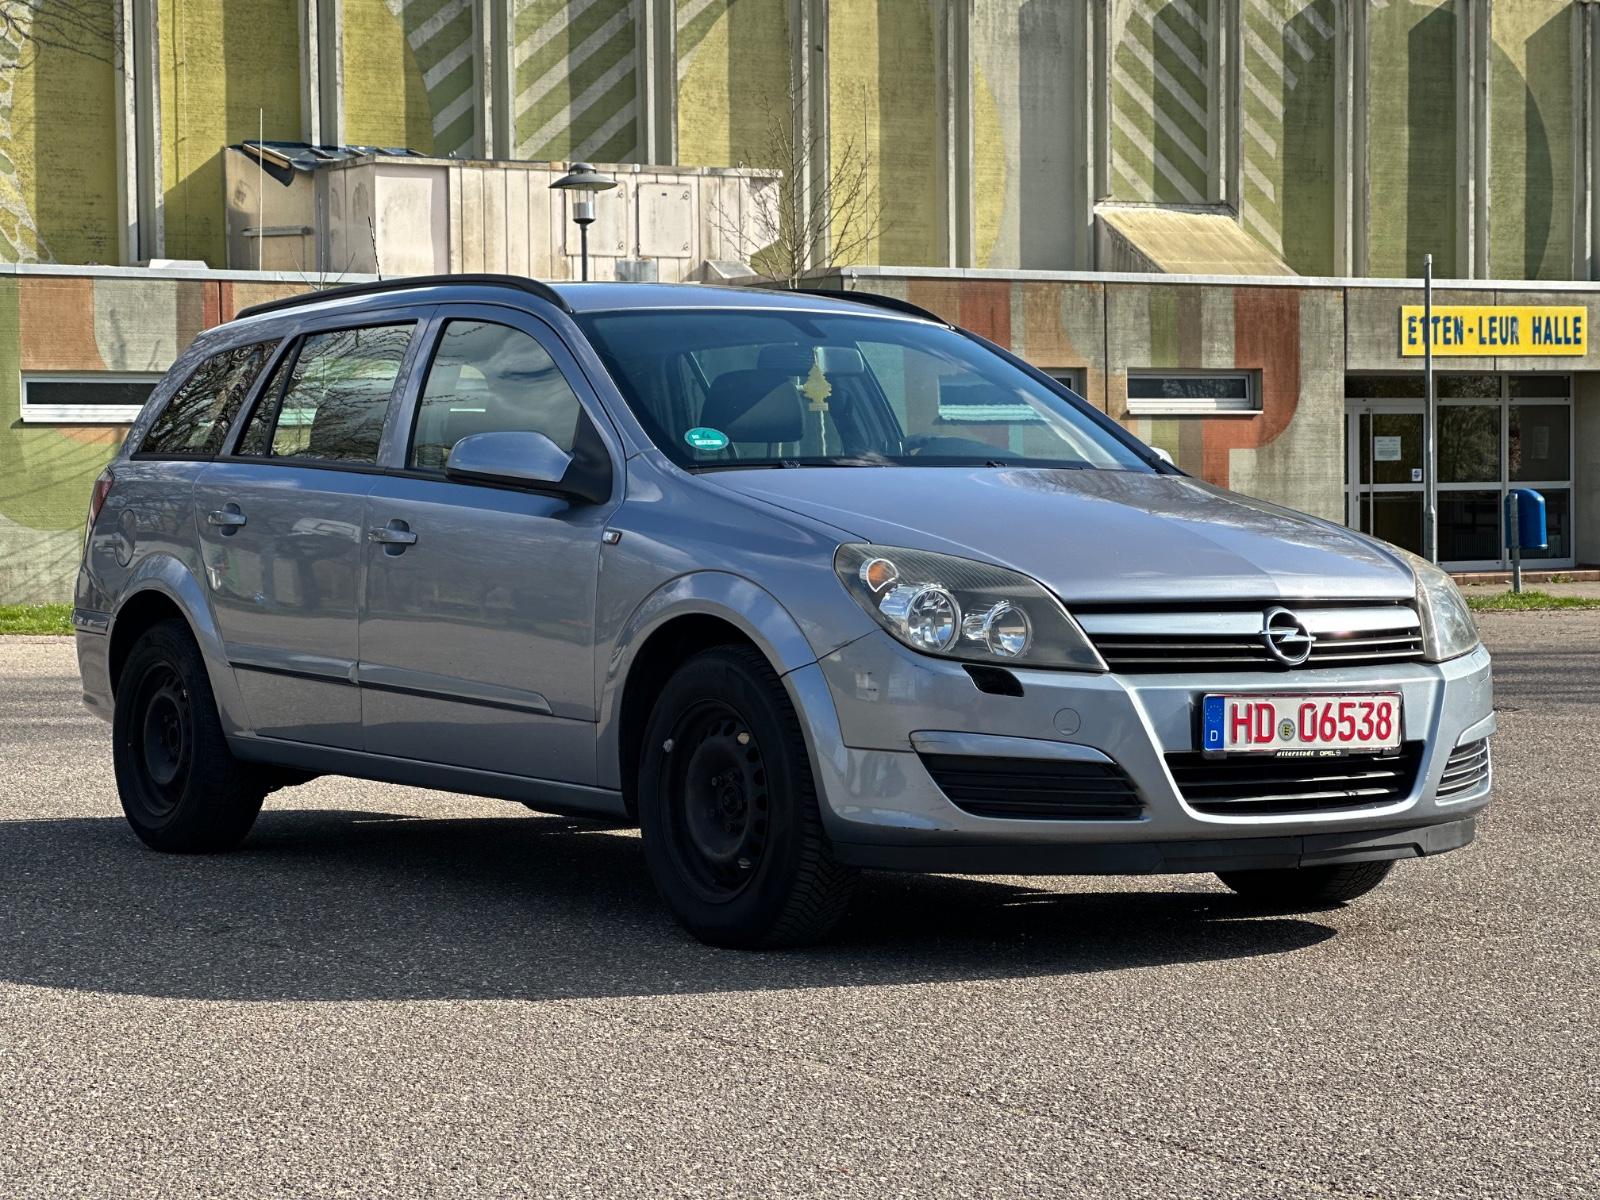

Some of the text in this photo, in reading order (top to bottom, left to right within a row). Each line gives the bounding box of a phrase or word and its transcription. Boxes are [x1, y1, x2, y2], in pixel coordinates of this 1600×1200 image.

[1532, 315, 1582, 345] HALLE
[1210, 730, 1218, 741] D
[1230, 702, 1392, 744] HD 06538
